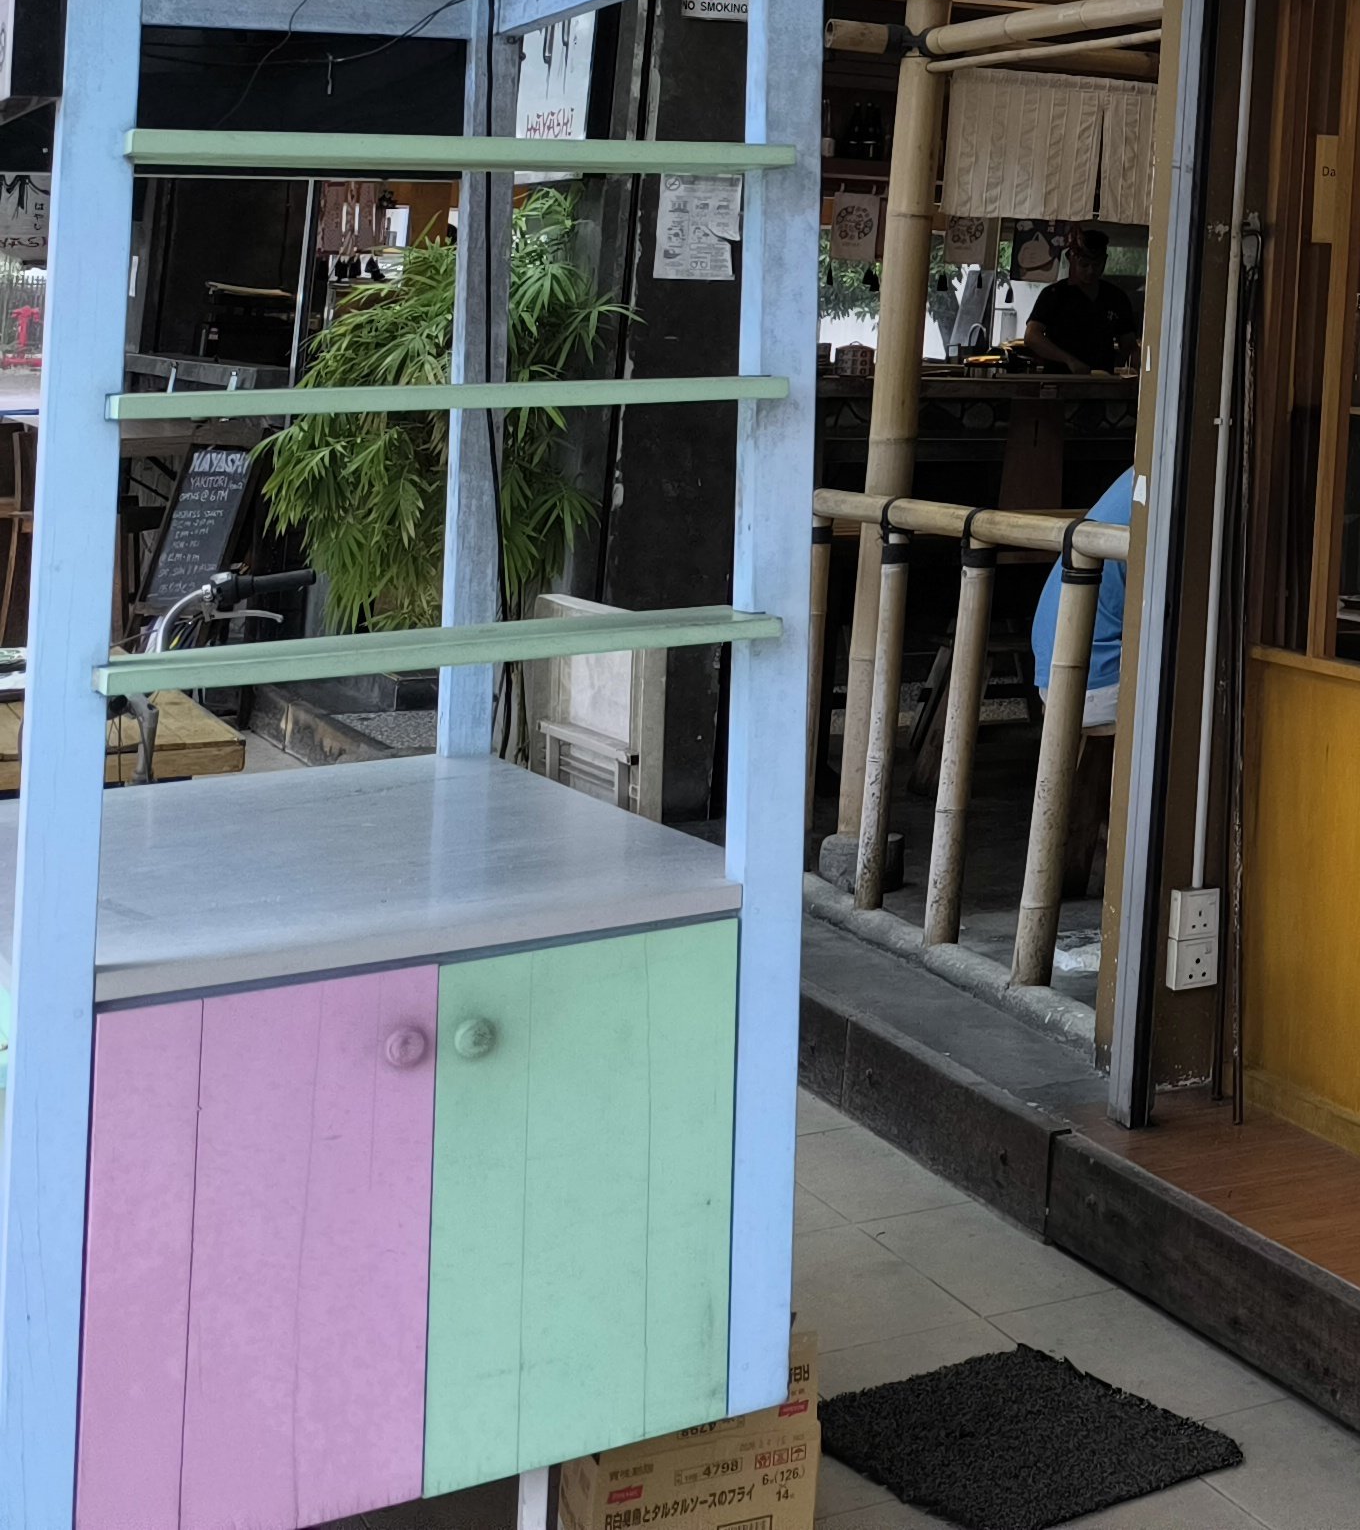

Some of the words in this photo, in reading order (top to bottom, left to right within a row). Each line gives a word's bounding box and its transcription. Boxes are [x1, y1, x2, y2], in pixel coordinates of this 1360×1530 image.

[700, 1, 748, 14] SMOKING
[190, 476, 229, 489] YAKITORI
[702, 1459, 740, 1477] 4798
